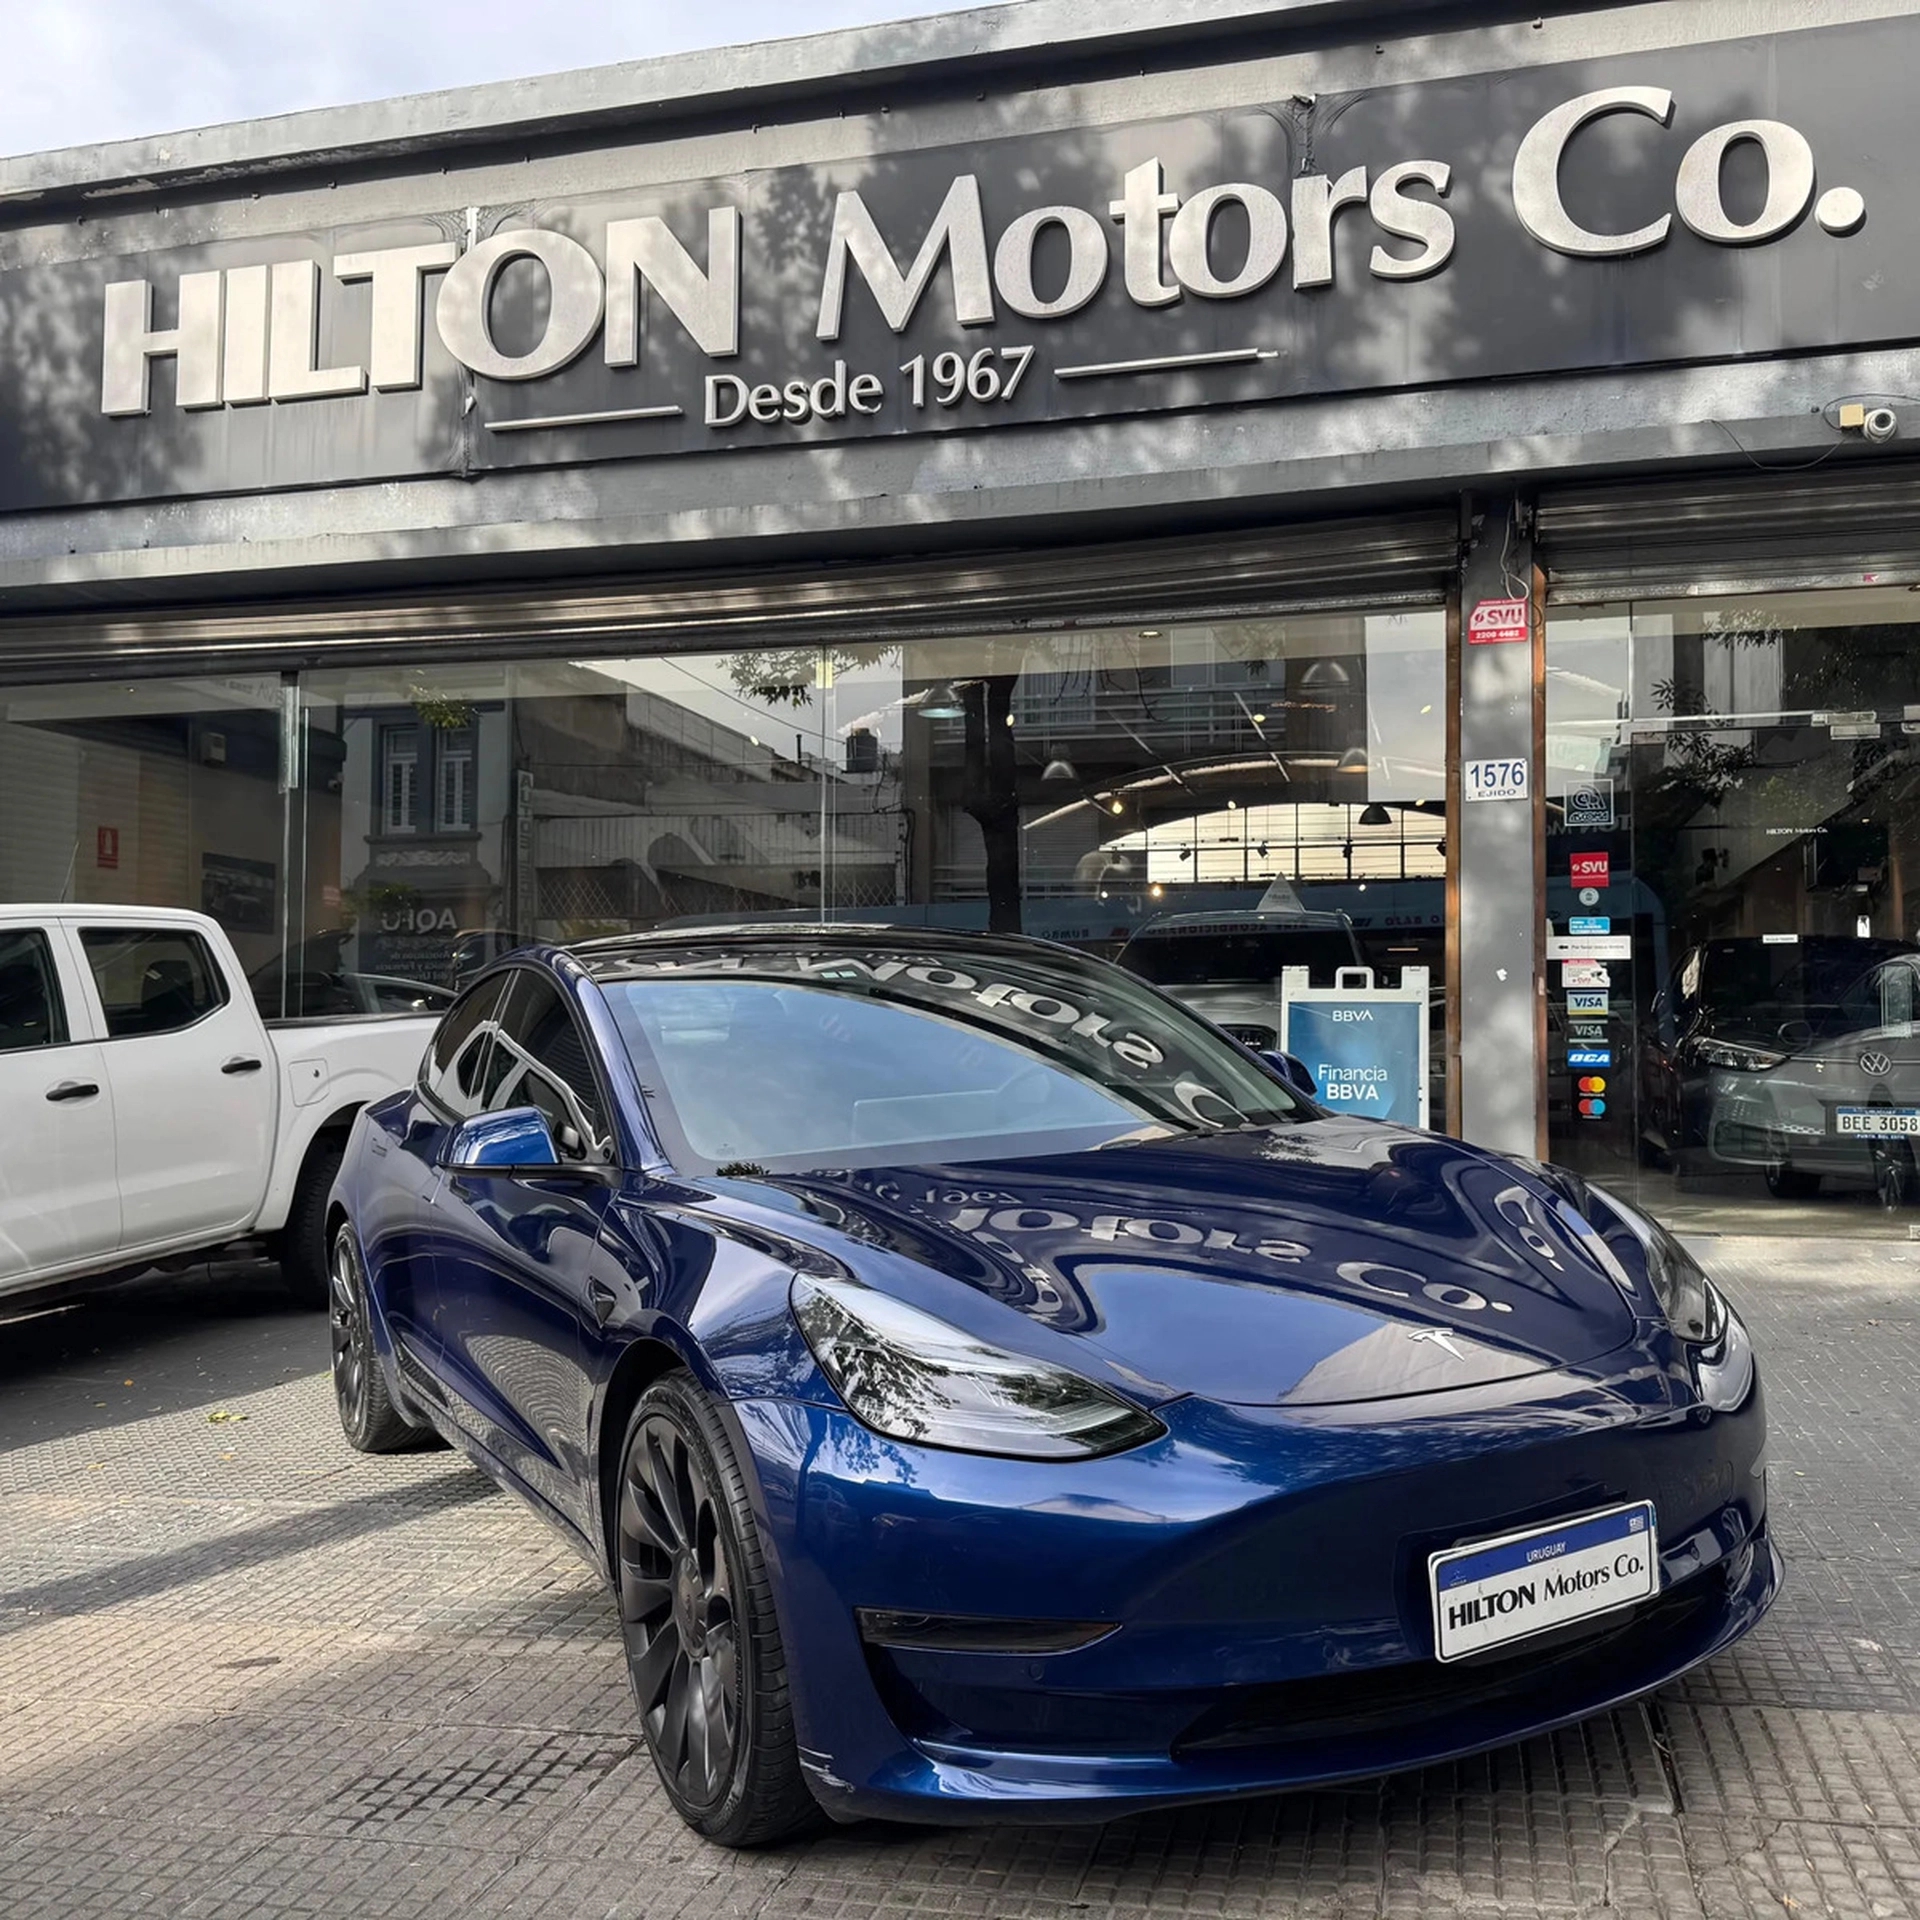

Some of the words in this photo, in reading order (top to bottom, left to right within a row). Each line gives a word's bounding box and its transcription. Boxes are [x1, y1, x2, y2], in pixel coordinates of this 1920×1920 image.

[102, 205, 740, 416] HILTON
[816, 156, 1456, 341] Motors
[1512, 85, 1866, 257] Co.
[704, 359, 884, 427] Desde
[900, 345, 1036, 407] 1967
[1487, 608, 1522, 625] SVU
[1470, 762, 1525, 788] 1576
[1478, 789, 1516, 798] EJIDO
[1581, 861, 1608, 874] SVU
[1573, 997, 1603, 1008] VISA
[1332, 1010, 1373, 1022] BBVA
[1573, 1025, 1603, 1036] VISA
[1318, 1064, 1388, 1081] Financia
[1326, 1083, 1379, 1101] BBVA
[1842, 1115, 1872, 1131] BEE
[1879, 1116, 1918, 1132] 3058
[1526, 1541, 1566, 1563] URUGUAY
[1448, 1582, 1536, 1630] HILTON
[1544, 1565, 1610, 1601] Motors
[1614, 1553, 1645, 1578] Co.
